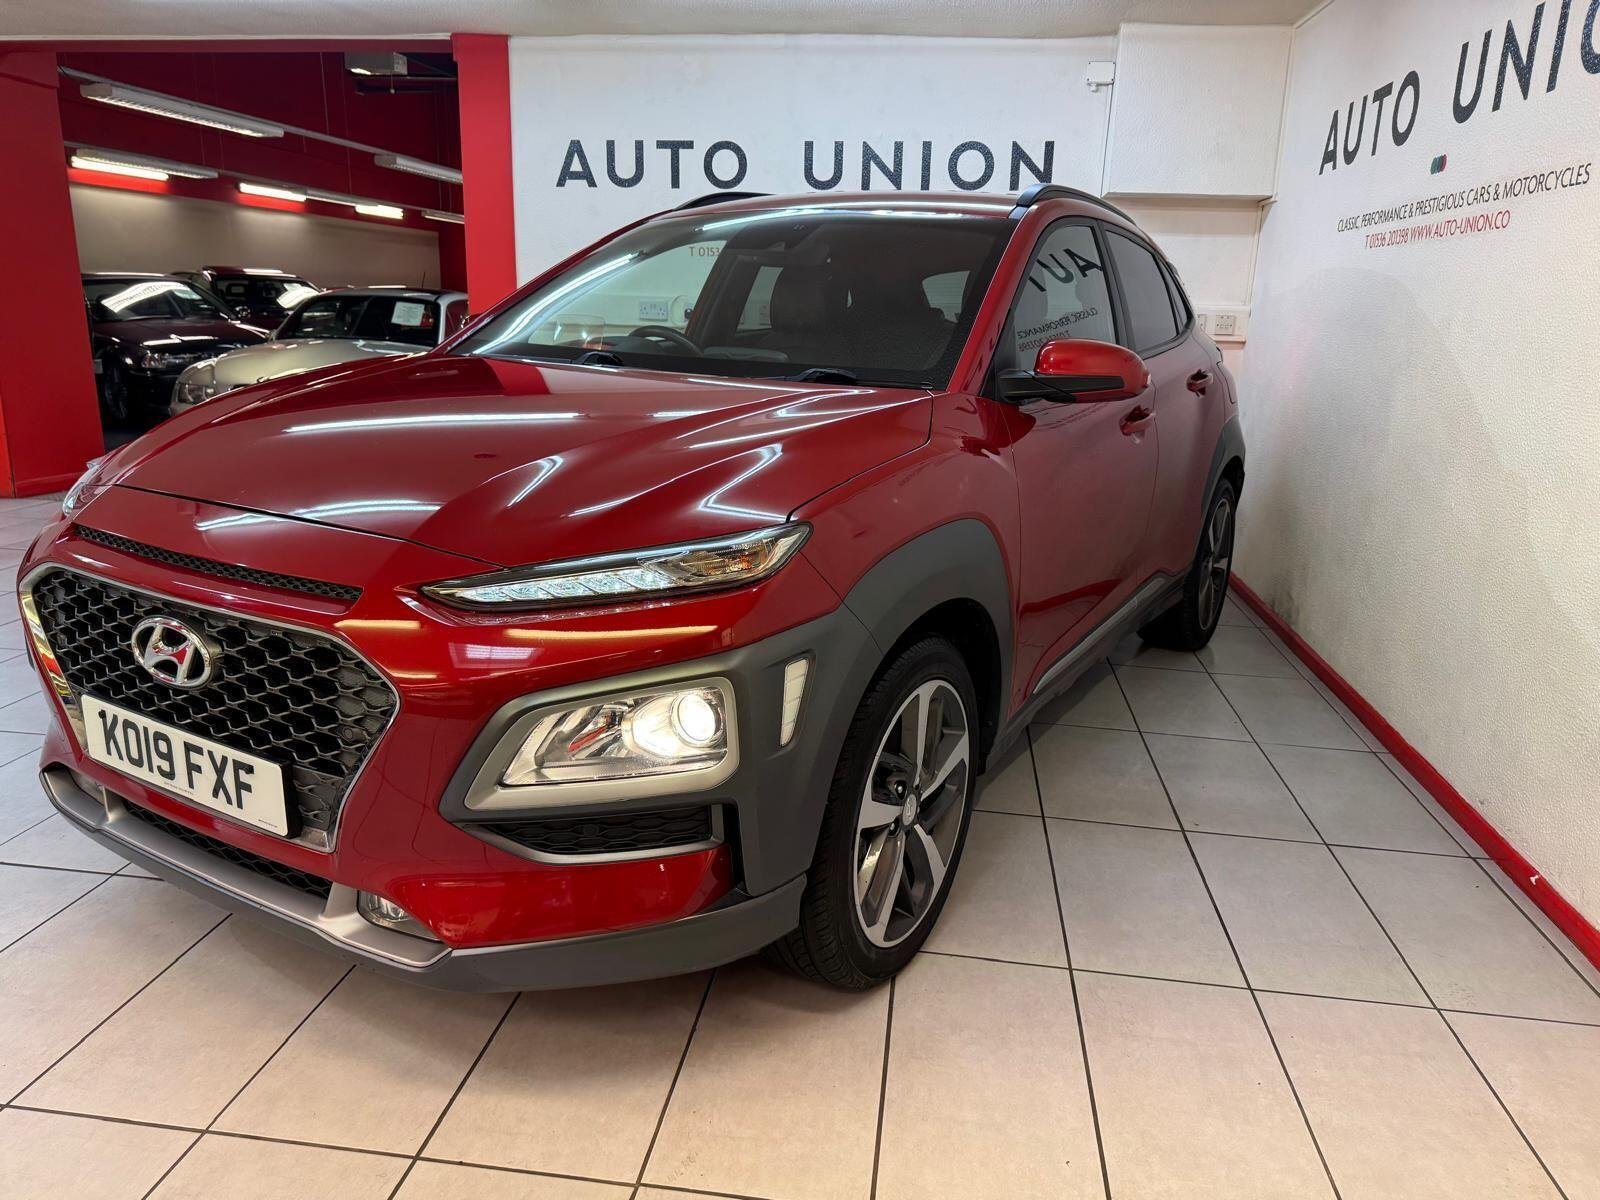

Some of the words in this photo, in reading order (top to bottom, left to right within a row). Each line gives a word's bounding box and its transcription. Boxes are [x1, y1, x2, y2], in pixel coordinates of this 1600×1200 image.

[1318, 70, 1420, 175] AUTO
[556, 139, 748, 190] AUTO
[803, 140, 1055, 191] UNION
[1360, 203, 1409, 229] PERFORMANCE
[1408, 201, 1415, 217] &
[1414, 191, 1466, 217] PRESTIGIOUS
[1466, 184, 1492, 206] CARS
[1492, 183, 1501, 201] &
[1502, 163, 1592, 199] MOTORCYCLES
[689, 247, 696, 257] T
[1409, 209, 1512, 243] WWW.AUTO-UNION.CO
[183, 740, 255, 810] FXF
